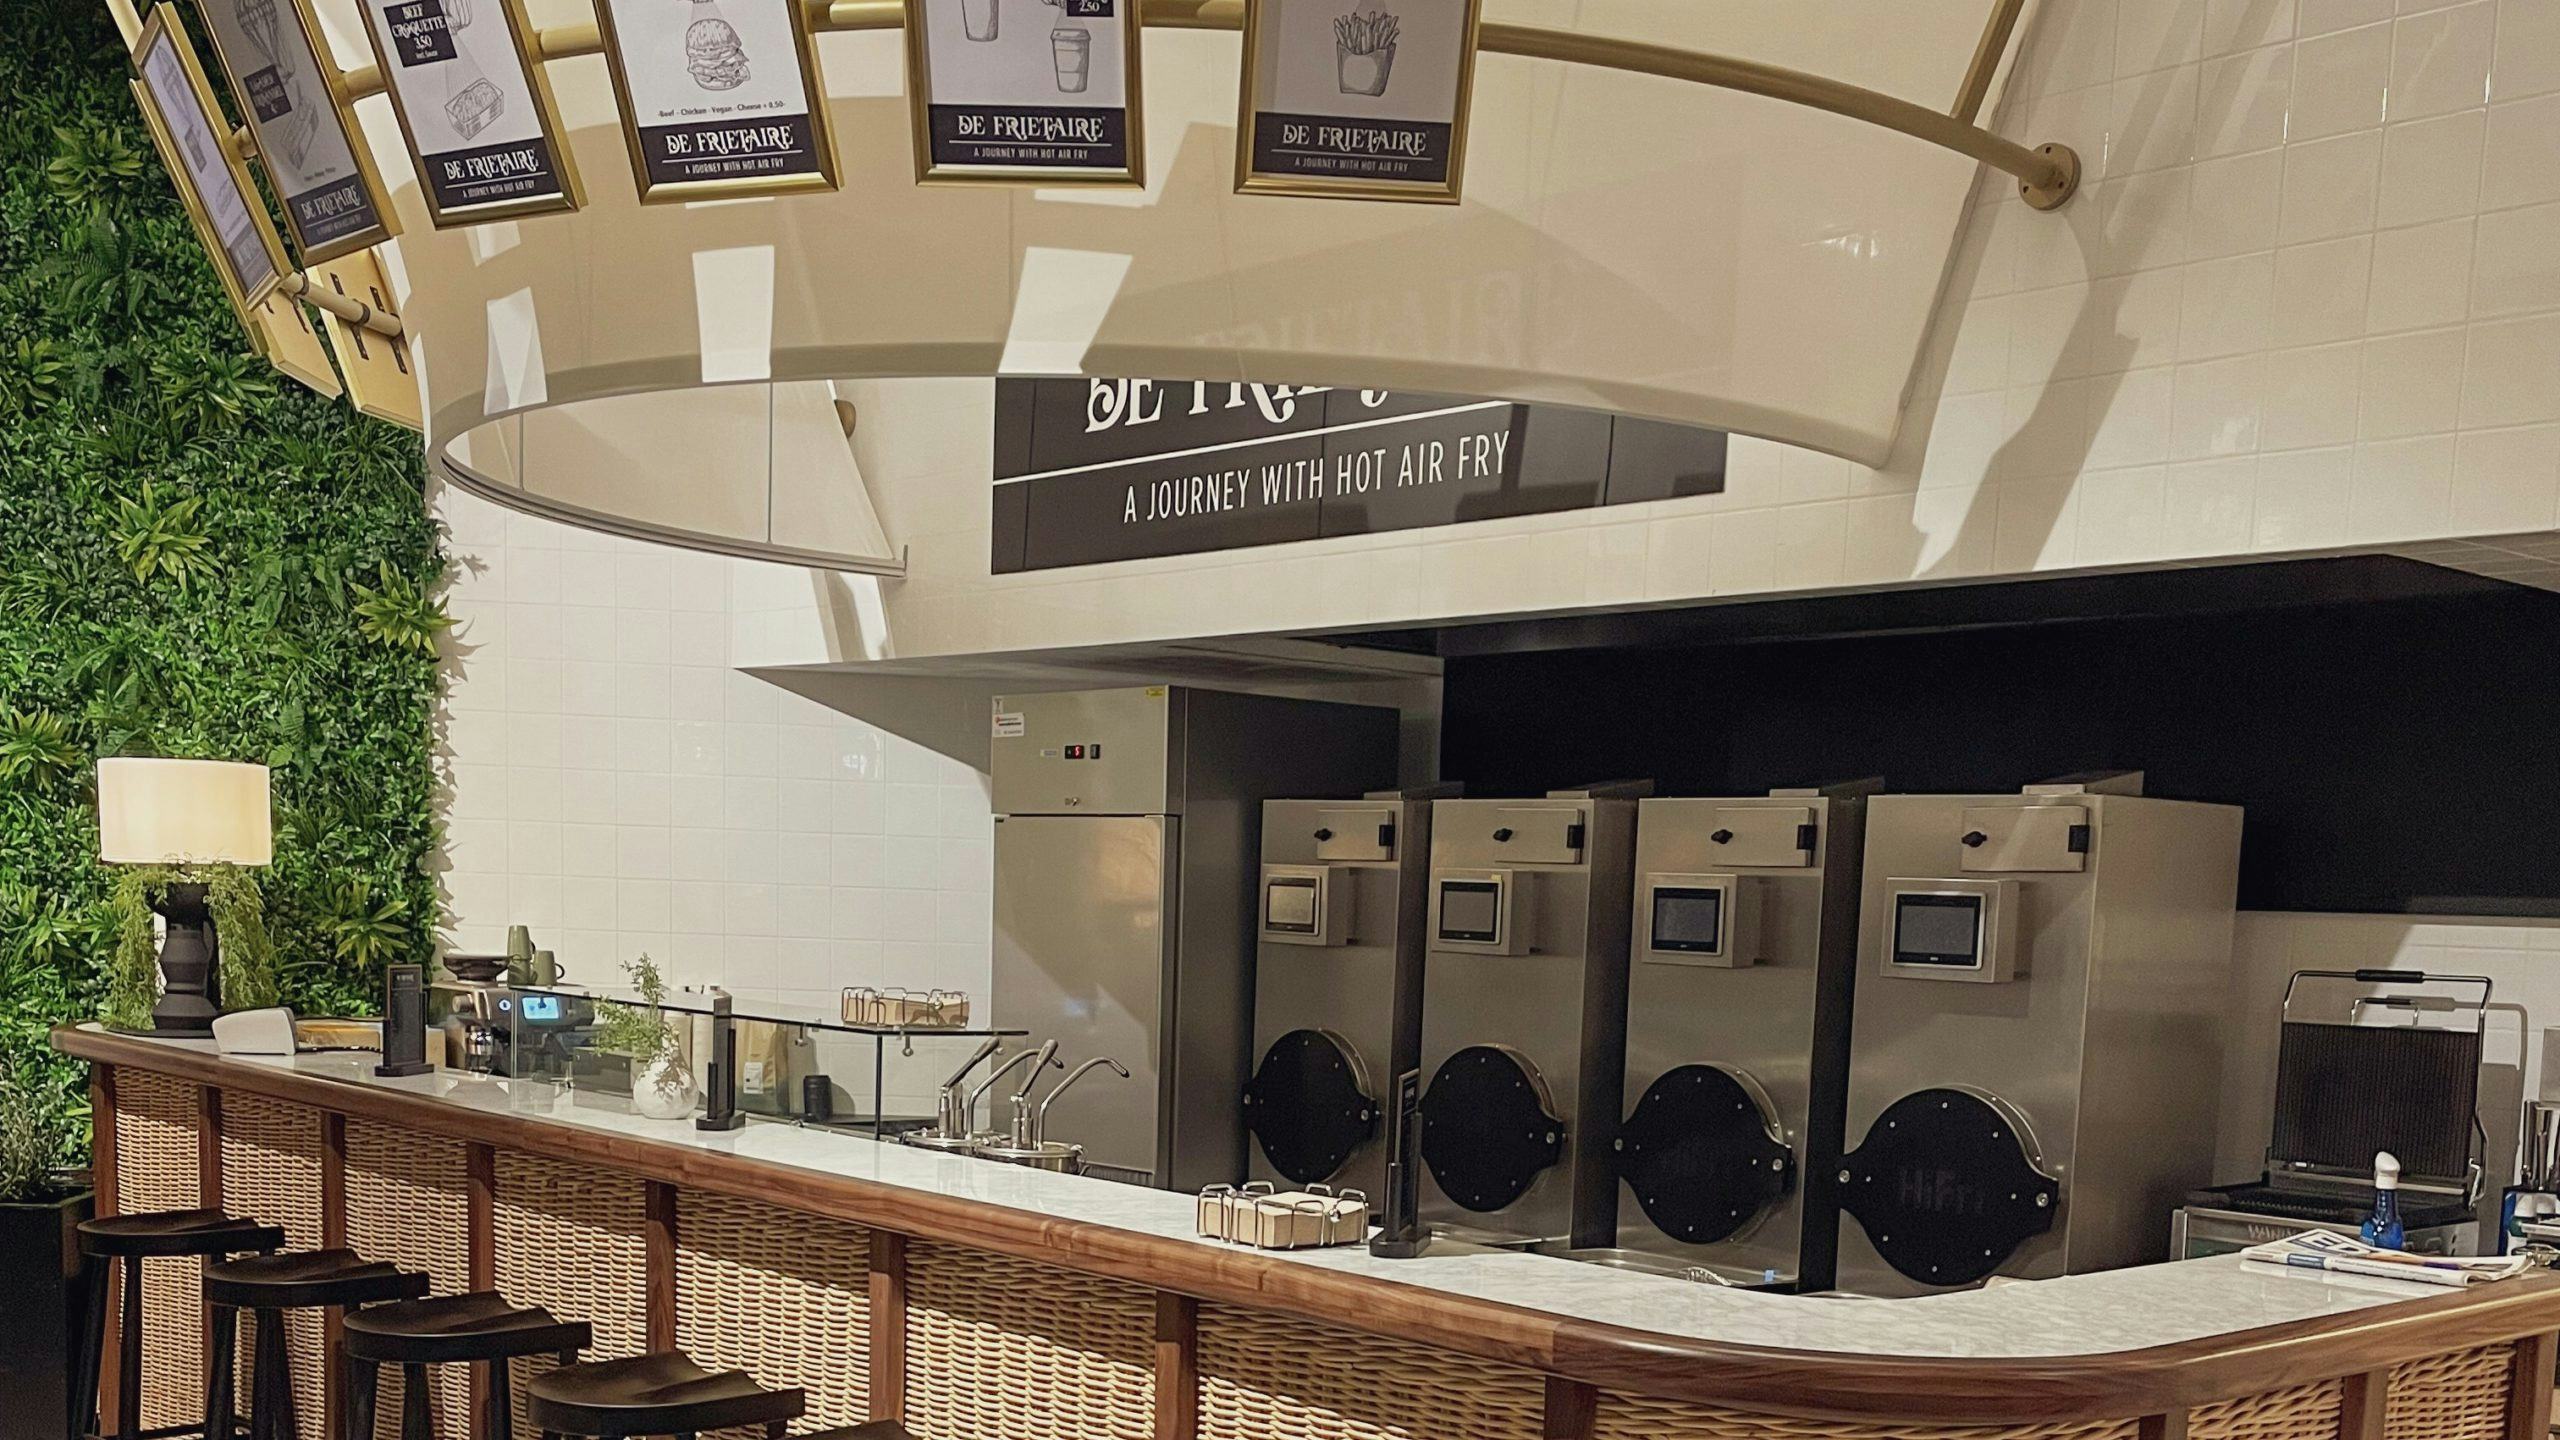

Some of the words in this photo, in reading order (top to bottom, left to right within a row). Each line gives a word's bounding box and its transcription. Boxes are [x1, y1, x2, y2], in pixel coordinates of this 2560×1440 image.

[392, 15, 446, 38] CROQUETTE
[711, 105, 733, 115] Vegan
[666, 134, 692, 154] DE
[695, 125, 794, 155] FRIETAIRE
[958, 115, 986, 135] DE
[993, 116, 1104, 142] FRIETAIRE
[1282, 124, 1310, 144] DE
[1317, 126, 1426, 156] FRIETAIRE
[443, 160, 466, 180] DE
[465, 149, 540, 179] FRIETAIRE
[692, 162, 721, 174] JOURNEY
[723, 160, 740, 172] WITH
[742, 159, 756, 171] HOT
[758, 158, 769, 169] AIR
[771, 158, 784, 168] FRY
[982, 148, 1016, 158] JOURNEY
[1018, 148, 1038, 158] WITH
[1040, 149, 1055, 159] HOT
[1058, 150, 1071, 159] AIR
[1073, 150, 1088, 160] FRY
[1302, 158, 1336, 168] JOURNEY
[1339, 160, 1359, 170] WITH
[1361, 161, 1376, 171] HOT
[1378, 162, 1391, 172] AIR
[1393, 162, 1408, 173] FRY
[1123, 485, 1137, 524] A
[1146, 468, 1251, 521] JOURNEY
[1261, 457, 1324, 505] WITH
[1336, 448, 1387, 495] HOT
[1397, 440, 1444, 488] AIR
[1457, 430, 1510, 480] FRY
